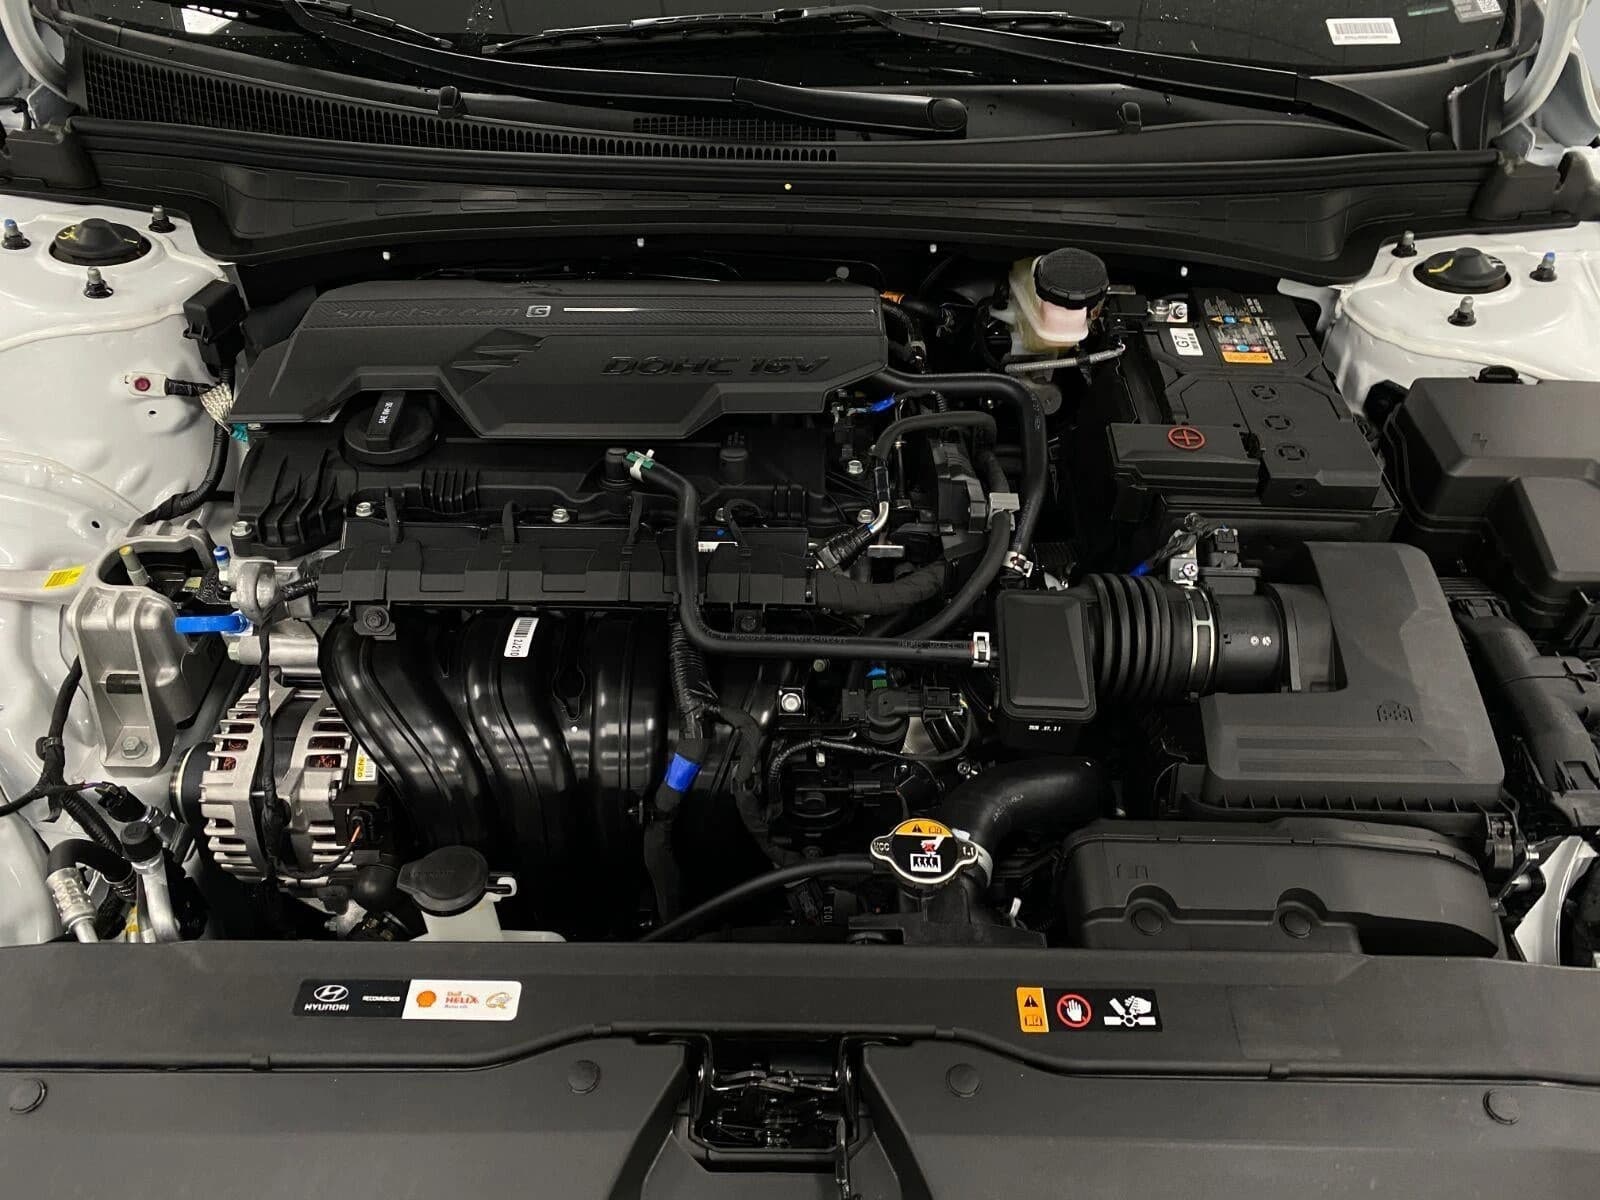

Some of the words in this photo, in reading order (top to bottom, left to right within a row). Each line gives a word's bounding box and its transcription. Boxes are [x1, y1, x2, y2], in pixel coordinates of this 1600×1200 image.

[1174, 335, 1190, 348] G7
[599, 356, 741, 375] DOHC
[749, 356, 830, 375] 16V
[303, 1003, 350, 1011] HYUNDAI
